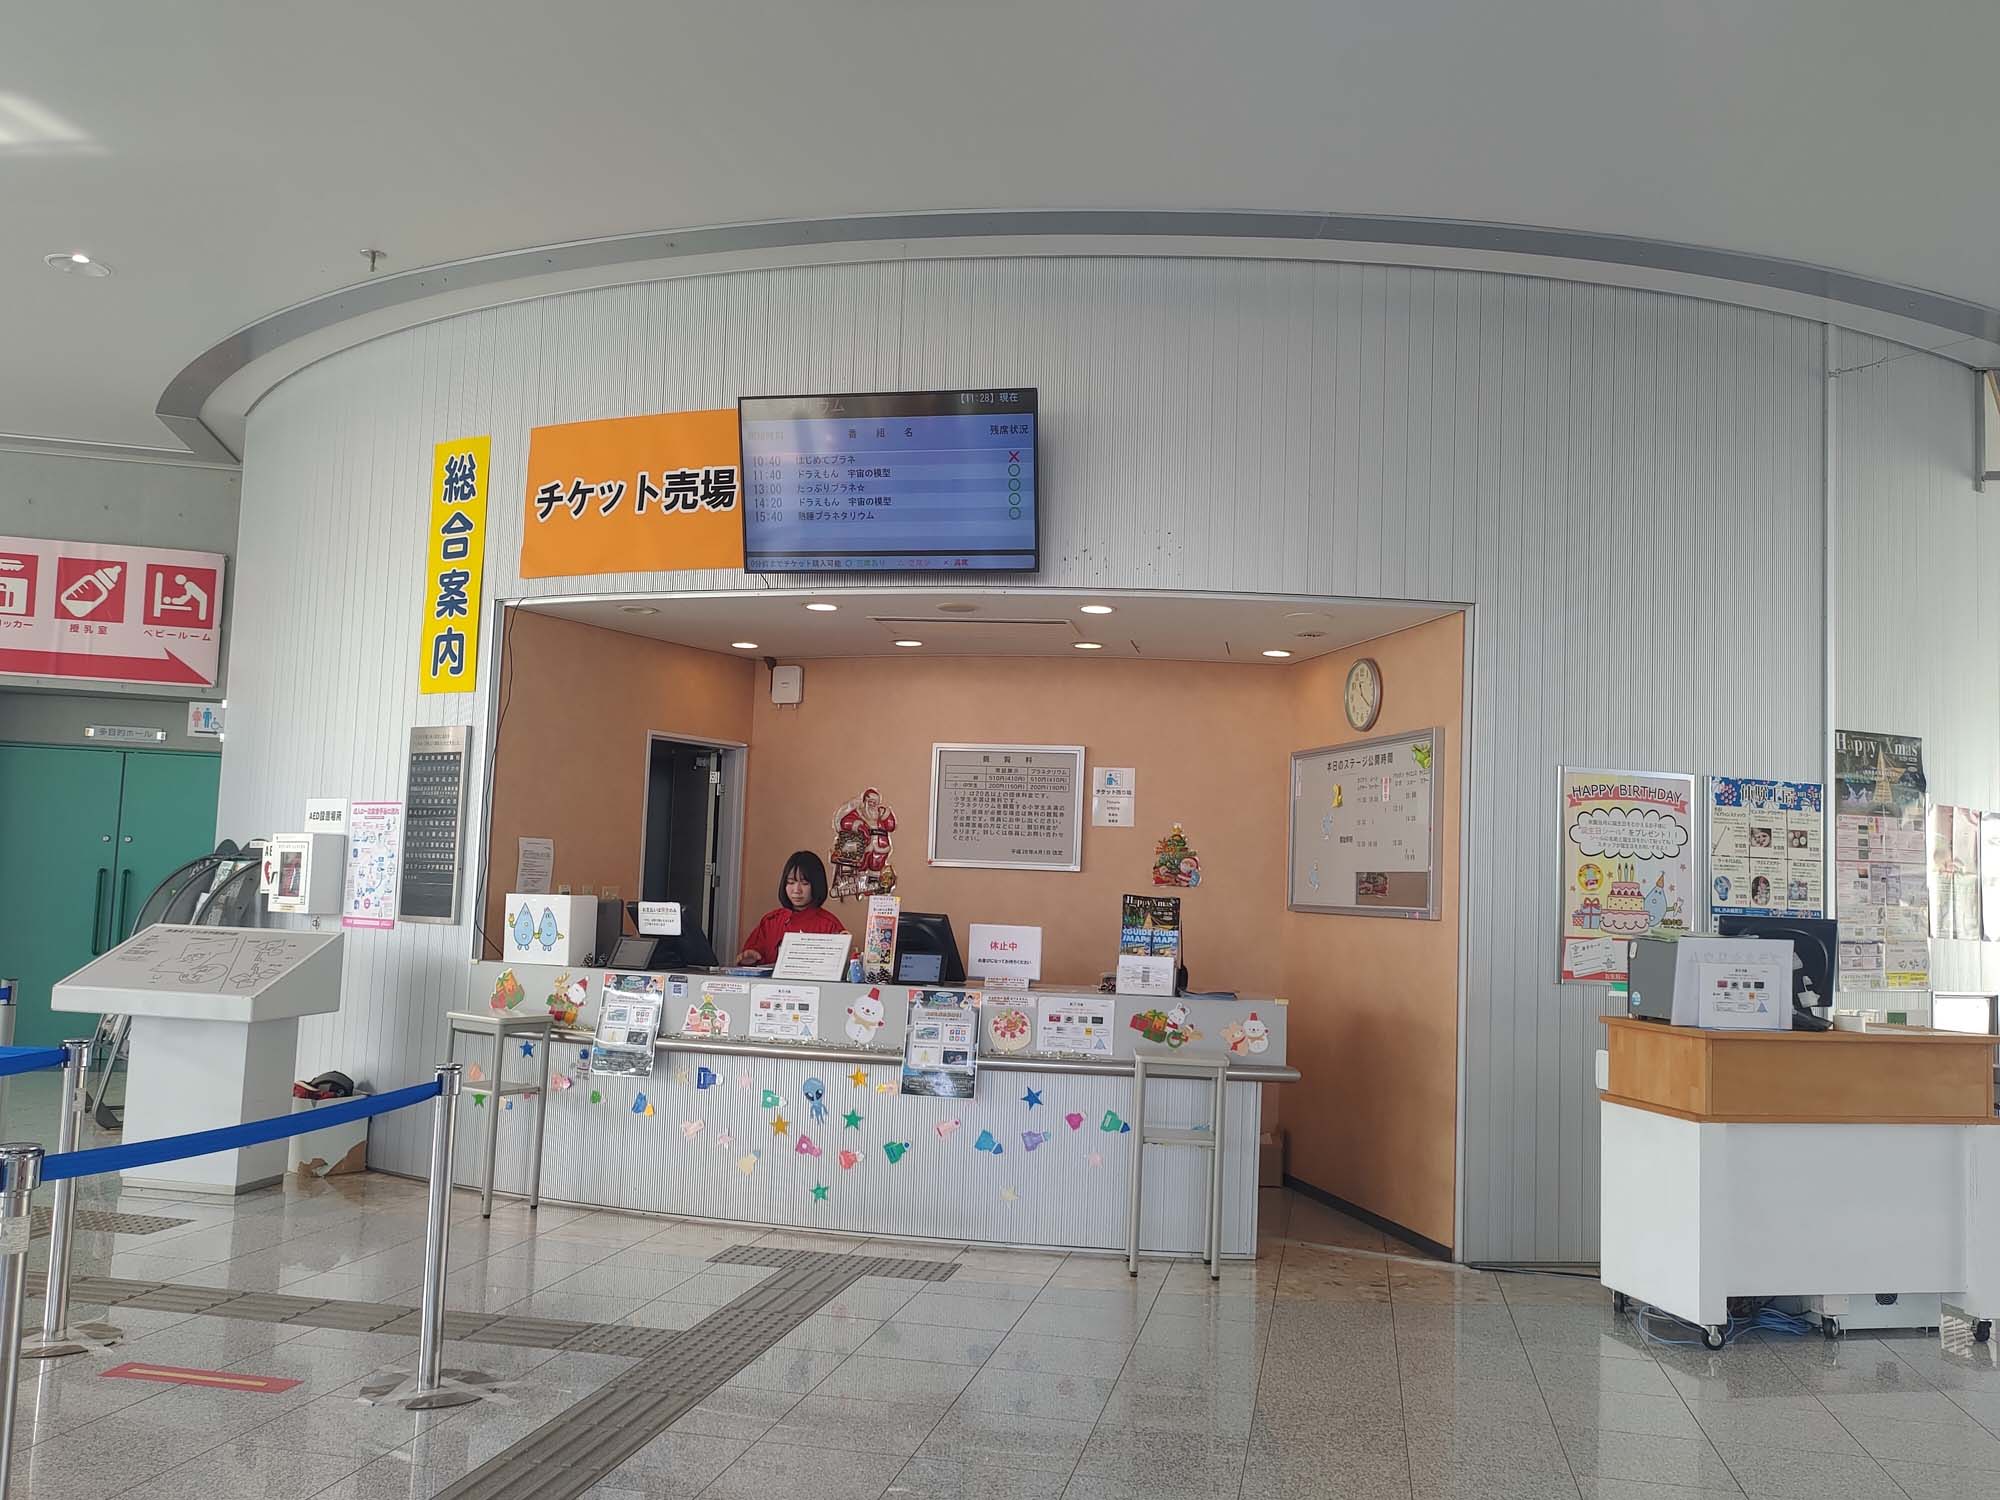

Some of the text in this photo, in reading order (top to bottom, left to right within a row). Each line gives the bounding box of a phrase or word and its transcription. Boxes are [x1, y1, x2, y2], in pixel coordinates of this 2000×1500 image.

[999, 392, 1019, 403] 現在
[990, 424, 1029, 436] 残席状況
[753, 455, 856, 467] 10:40 はじめてプラネ
[753, 468, 891, 481] 11:40 ドラえもん 宇宙の模型
[536, 467, 737, 520] チケット売場
[753, 484, 782, 495] 13:00
[754, 496, 892, 509] 14:20 ドラえもん 宇宙の模型
[754, 511, 783, 522] 15:40
[431, 453, 477, 677] 総合案内
[0, 619, 33, 629] ッカー
[69, 623, 108, 635] 授乳室
[143, 629, 212, 642] ベビールーム
[1836, 732, 1918, 759] Happy Xmas
[1031, 768, 1067, 776] プラネタリウム
[1572, 784, 1682, 804] HAPPY BIRTHDAY
[1153, 929, 1179, 937] GUIDE
[990, 941, 1018, 952] 休止中
